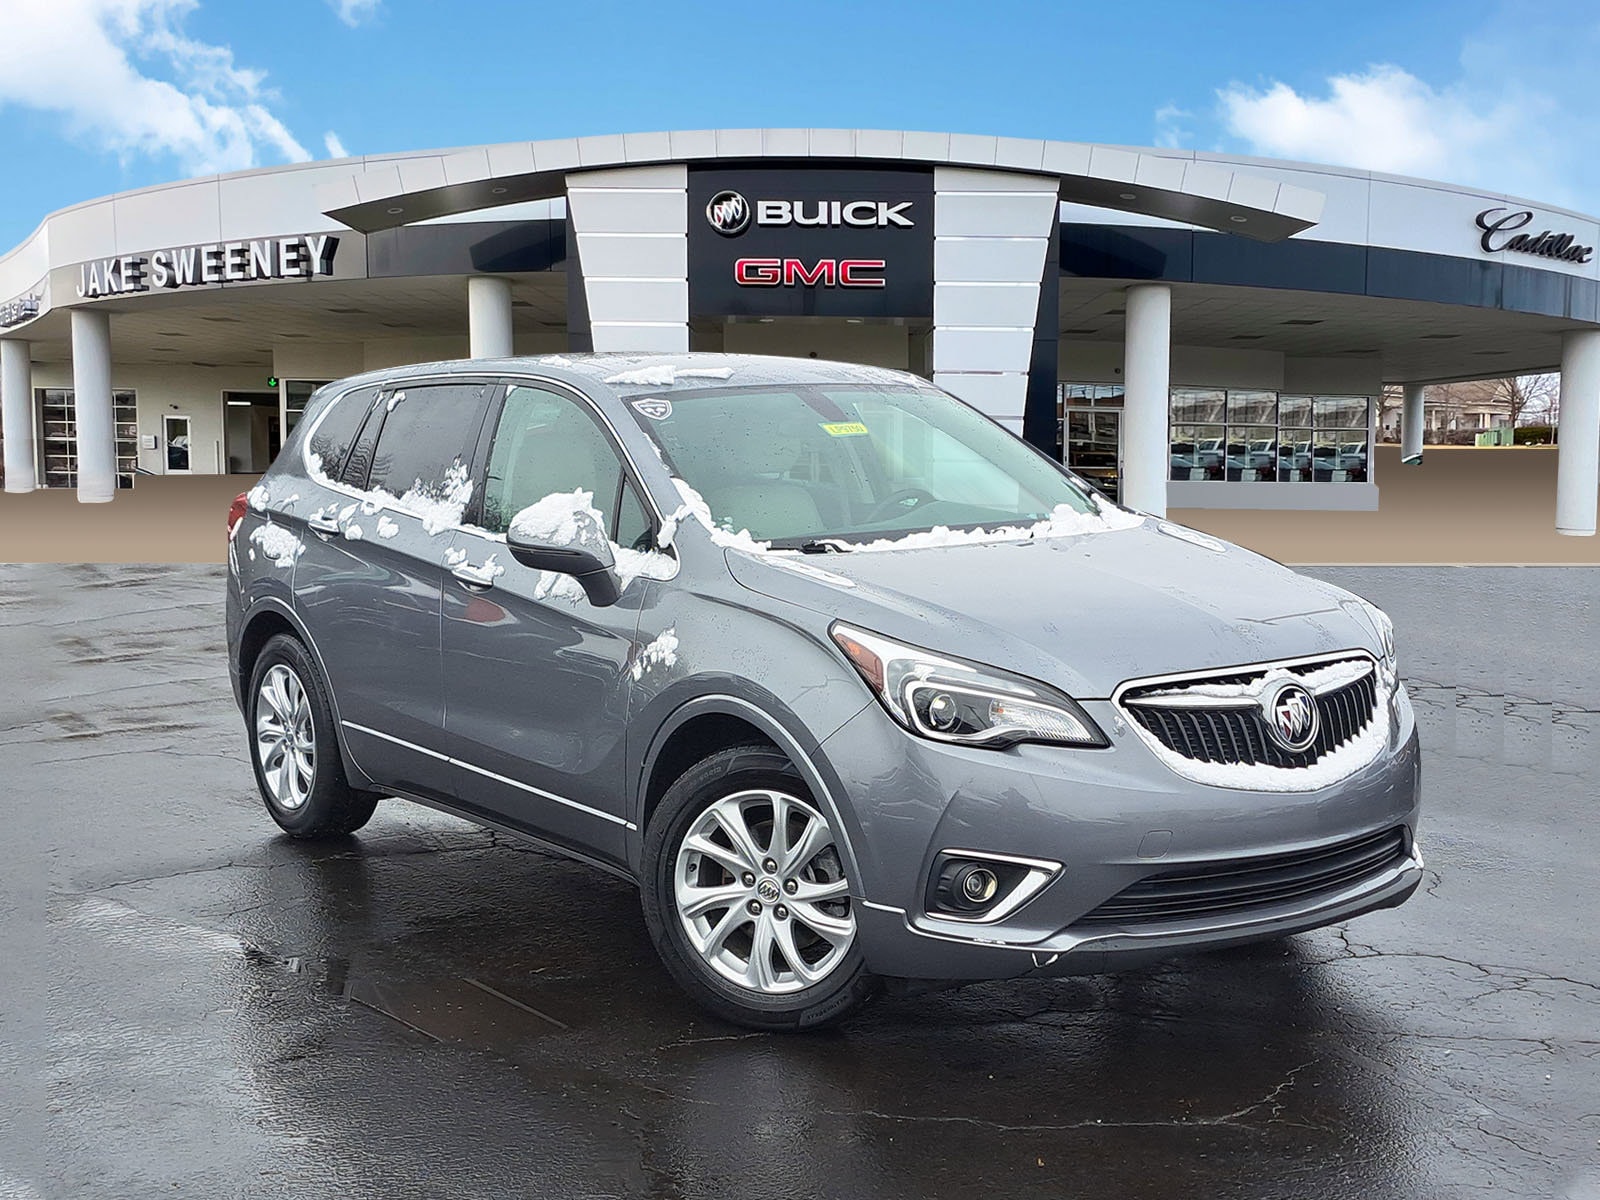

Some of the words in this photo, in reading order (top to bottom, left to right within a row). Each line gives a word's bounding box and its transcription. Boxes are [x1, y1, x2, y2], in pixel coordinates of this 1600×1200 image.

[757, 200, 915, 226] BUICK
[1475, 207, 1593, 264] Cadillac
[76, 256, 138, 298] JAKE
[151, 234, 332, 289] SWEENEY
[734, 257, 886, 287] GMC
